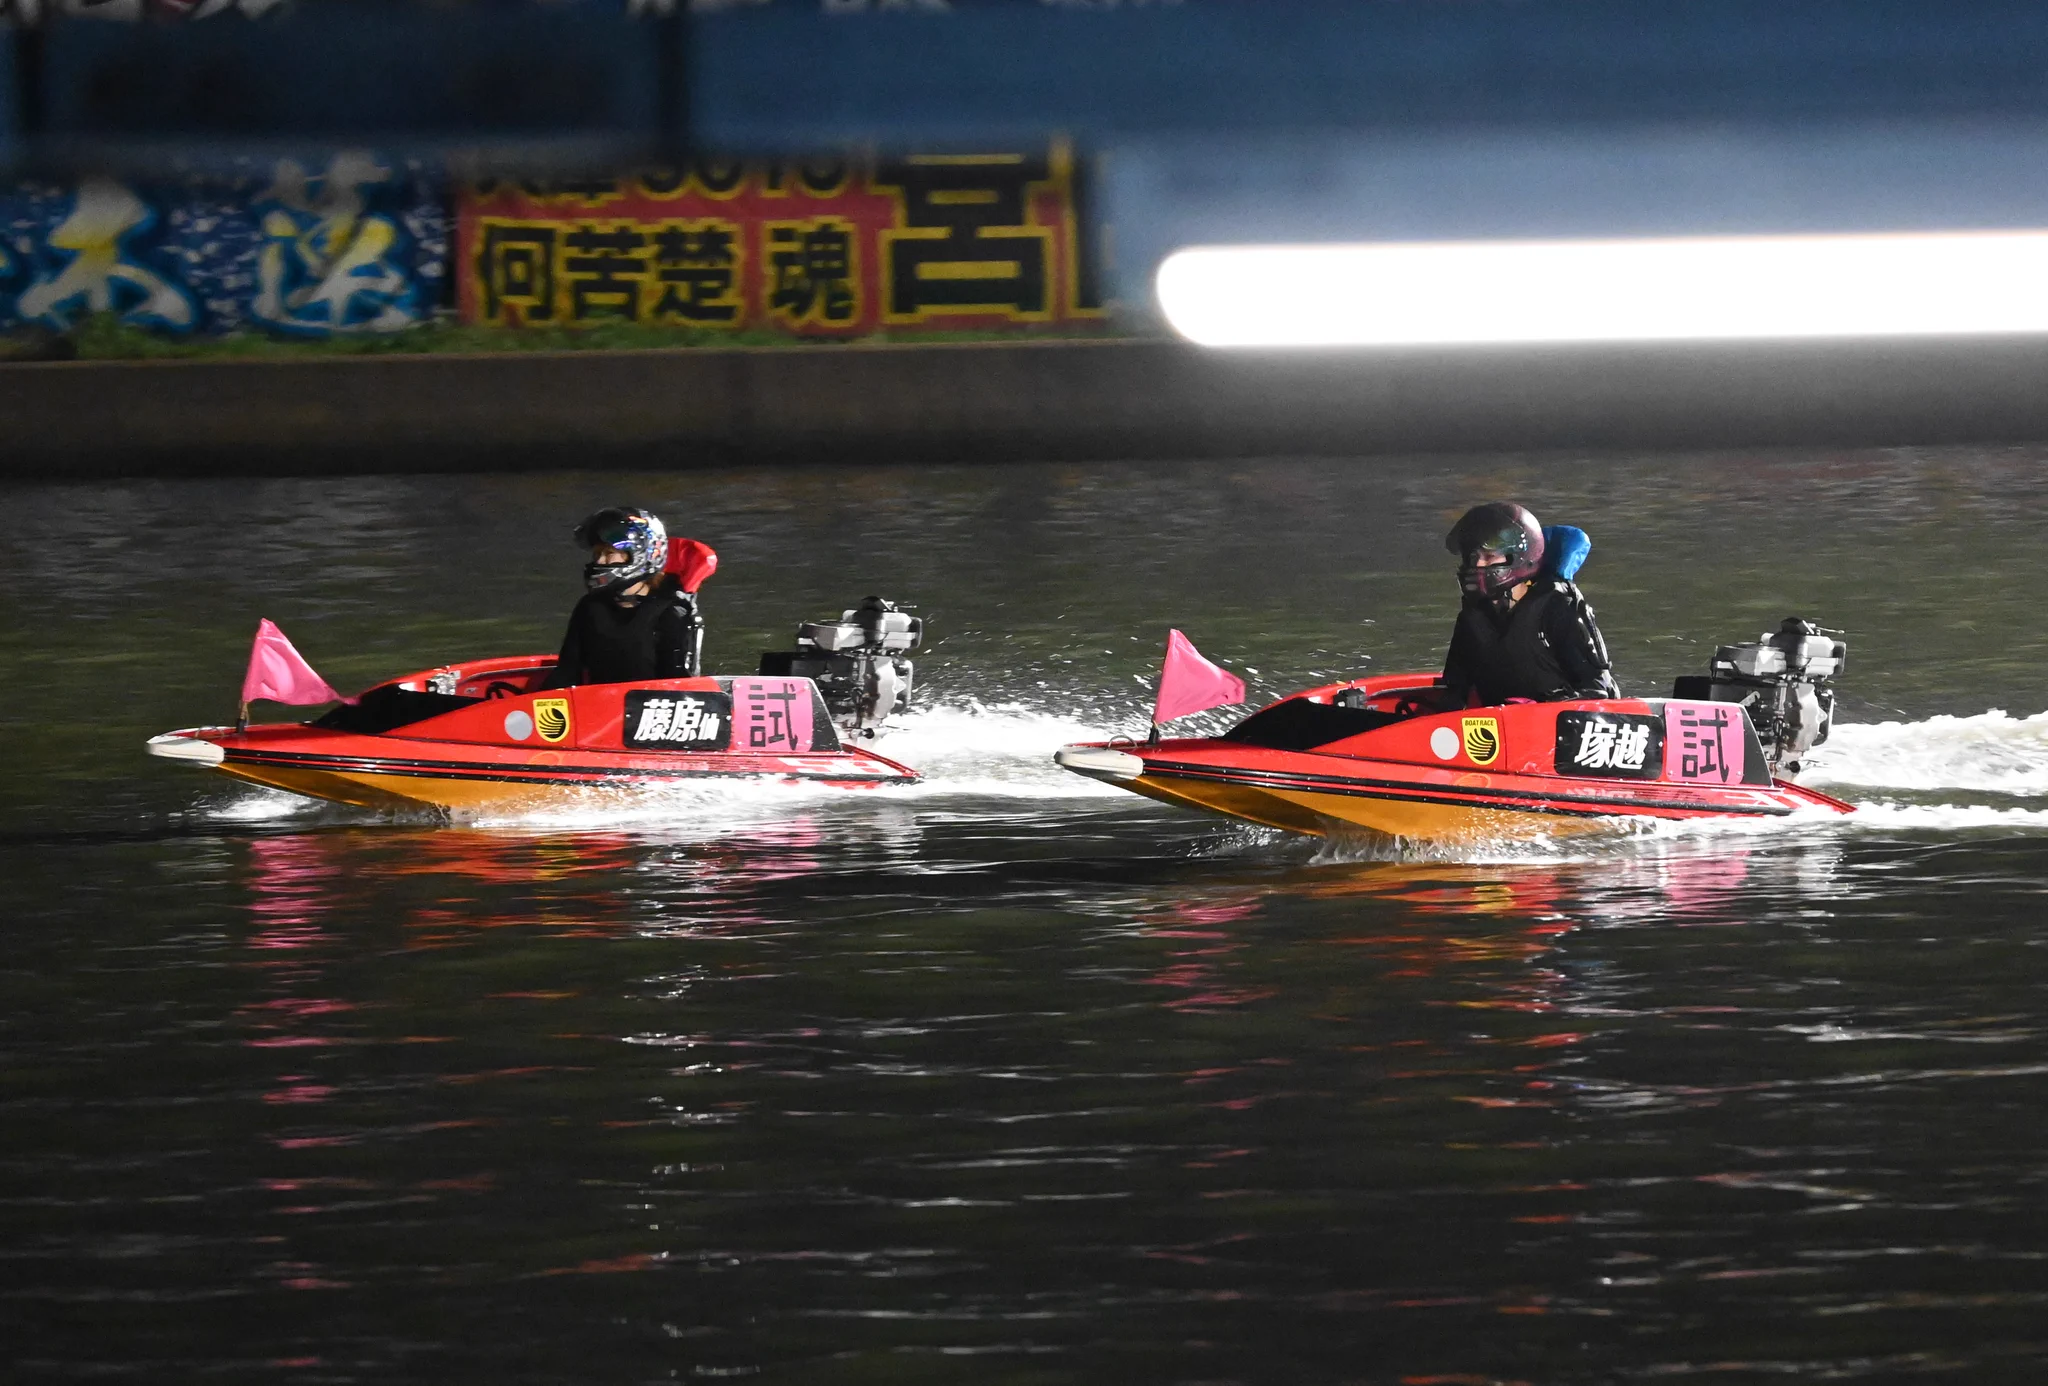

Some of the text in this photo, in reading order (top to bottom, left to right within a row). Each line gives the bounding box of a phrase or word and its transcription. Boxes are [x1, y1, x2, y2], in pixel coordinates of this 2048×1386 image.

[748, 682, 798, 750] 試
[1573, 721, 1650, 769] 塚越
[1680, 708, 1730, 783] 試
